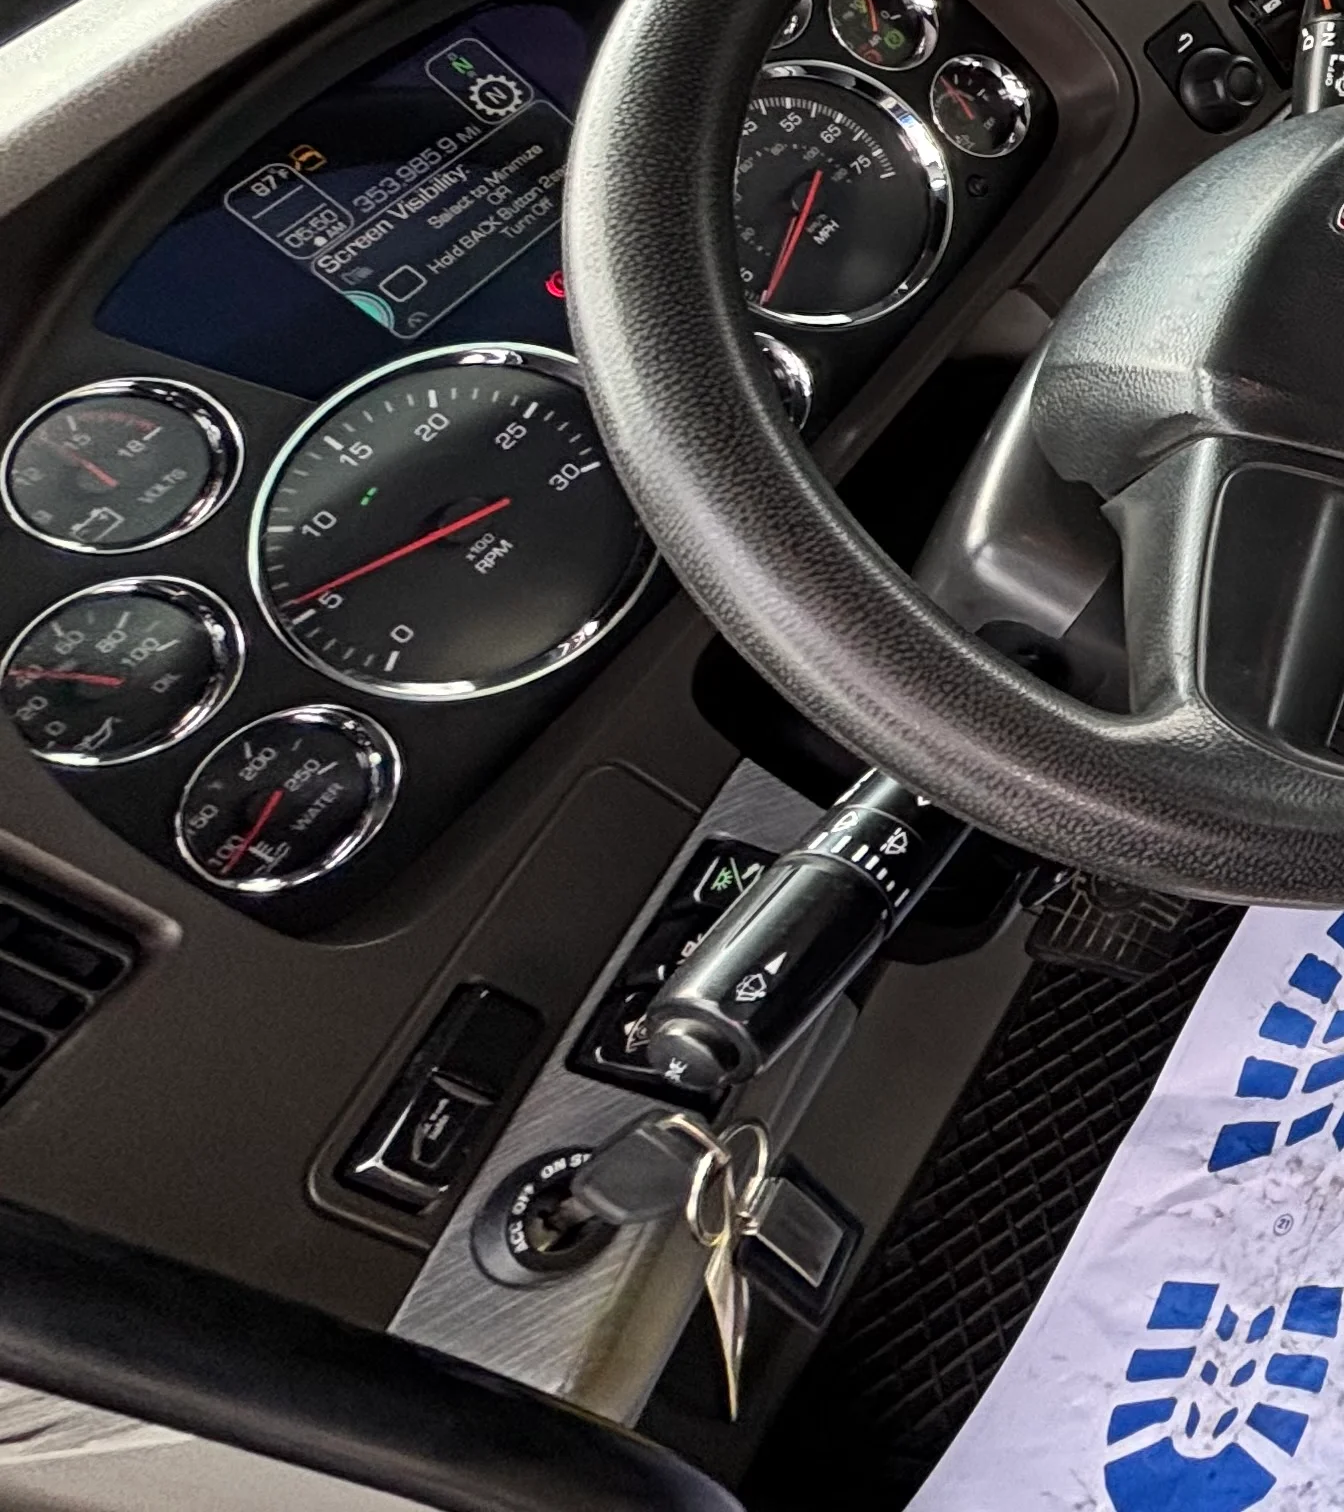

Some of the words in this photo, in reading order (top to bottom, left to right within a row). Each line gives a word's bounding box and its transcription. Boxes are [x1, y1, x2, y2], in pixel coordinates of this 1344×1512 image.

[1303, 35, 1315, 51] D
[1321, 32, 1336, 47] N
[452, 56, 474, 75] N
[485, 86, 508, 105] N
[456, 124, 482, 144] Mi
[779, 112, 803, 133] 55
[820, 124, 842, 144] 65
[850, 155, 872, 175] 75
[427, 195, 475, 230] Select
[470, 184, 489, 199] to
[484, 144, 544, 187] Minimize
[486, 185, 513, 206] OR
[325, 221, 347, 239] AM
[426, 248, 466, 275] Hold
[458, 214, 503, 250] BACK
[496, 187, 543, 221] Button
[500, 214, 536, 239] Turn
[531, 196, 556, 217] Off
[813, 219, 840, 246] MPH
[317, 219, 394, 274] Screen
[414, 412, 450, 442] 20
[495, 422, 528, 450] 25
[339, 441, 374, 467] 15
[548, 463, 580, 491] 30
[301, 510, 338, 537] 10
[474, 539, 514, 574] RPM
[318, 590, 344, 610] 5
[55, 630, 85, 655] 60
[95, 629, 128, 654] 80
[390, 624, 414, 644] 0
[121, 637, 160, 667] 100
[16, 695, 48, 721] 20
[44, 720, 67, 737] 0
[238, 746, 278, 782] 200
[284, 758, 321, 793] 250
[289, 782, 344, 831] WATER
[186, 804, 219, 837] 150
[207, 834, 245, 867] 100
[540, 1157, 567, 1180] ON
[512, 1183, 535, 1216] OFF
[508, 1220, 529, 1254] ACC
